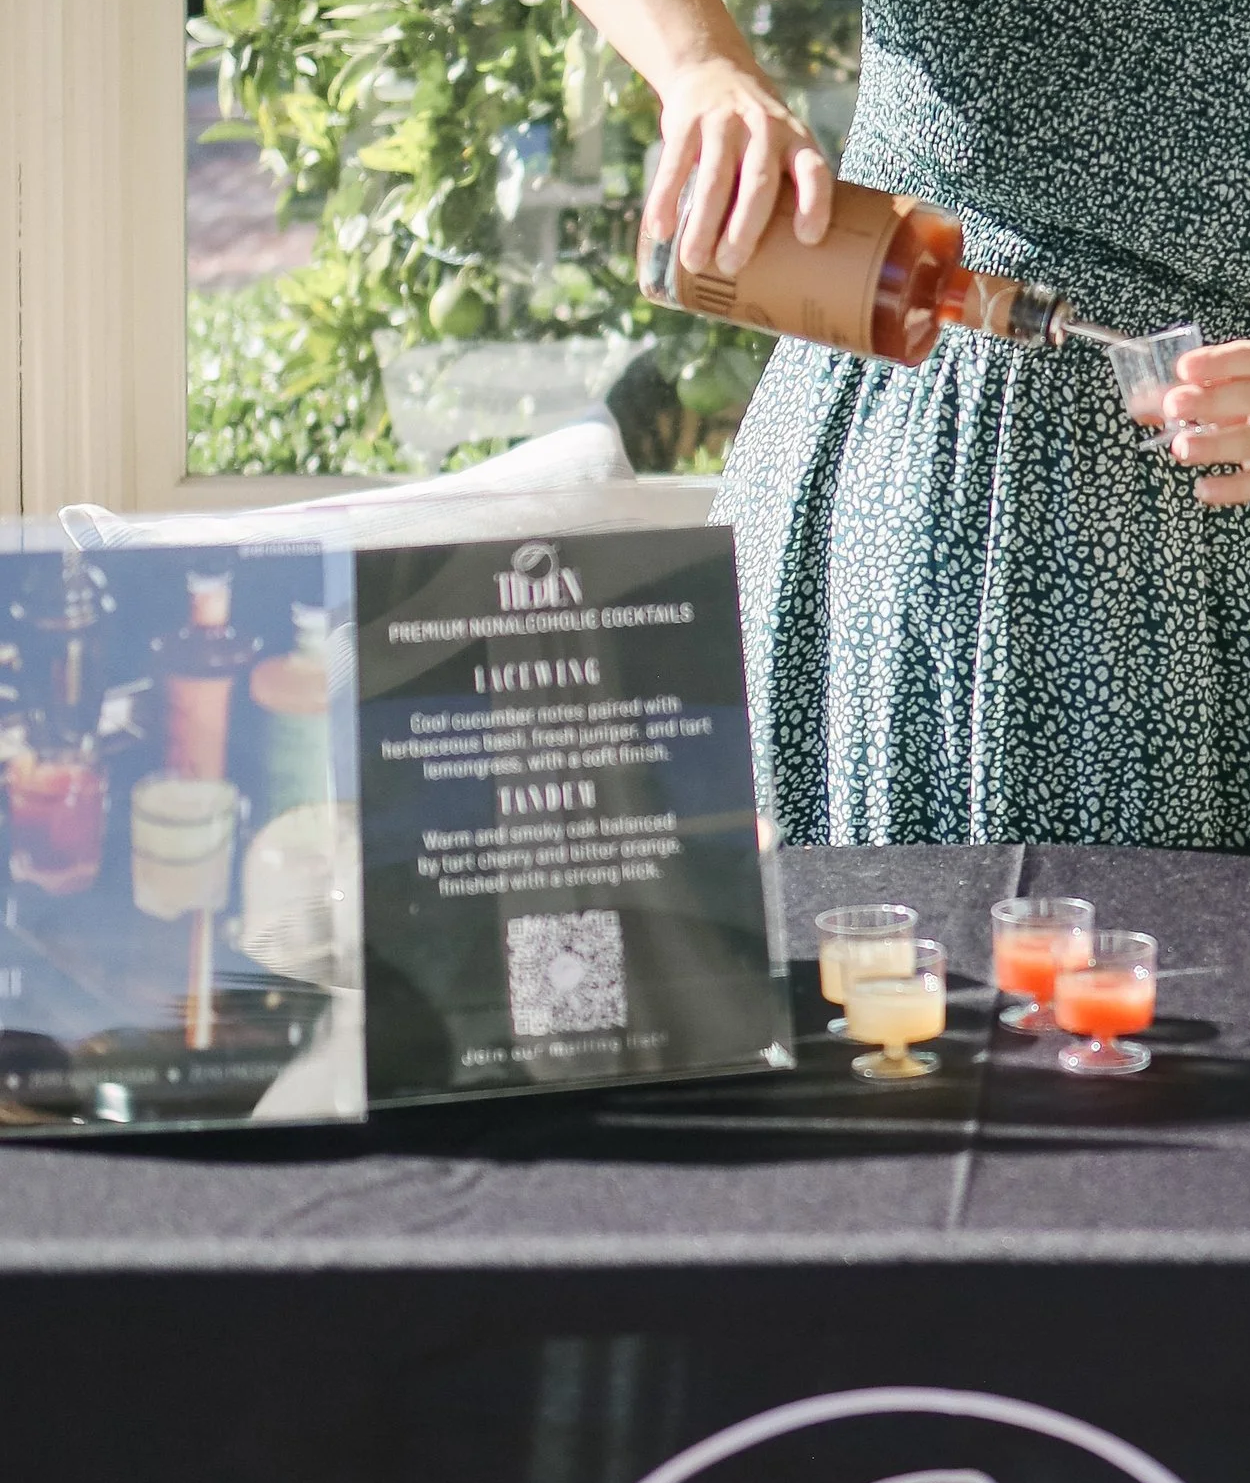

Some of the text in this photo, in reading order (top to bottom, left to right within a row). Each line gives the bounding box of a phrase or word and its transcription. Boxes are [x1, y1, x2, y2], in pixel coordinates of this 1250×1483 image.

[389, 619, 467, 644] PREMIUM
[602, 602, 695, 629] COCKTAILS
[410, 695, 683, 734] Cool cucumber notes paired with
[646, 718, 679, 740] and
[527, 749, 567, 771] with
[568, 751, 581, 769] a
[422, 811, 677, 851] Warm and smoky oak balanced
[417, 854, 440, 879] by
[477, 848, 534, 871] cherry
[535, 844, 569, 865] and
[510, 869, 550, 892] with
[551, 870, 564, 888] a
[564, 865, 621, 887] strong
